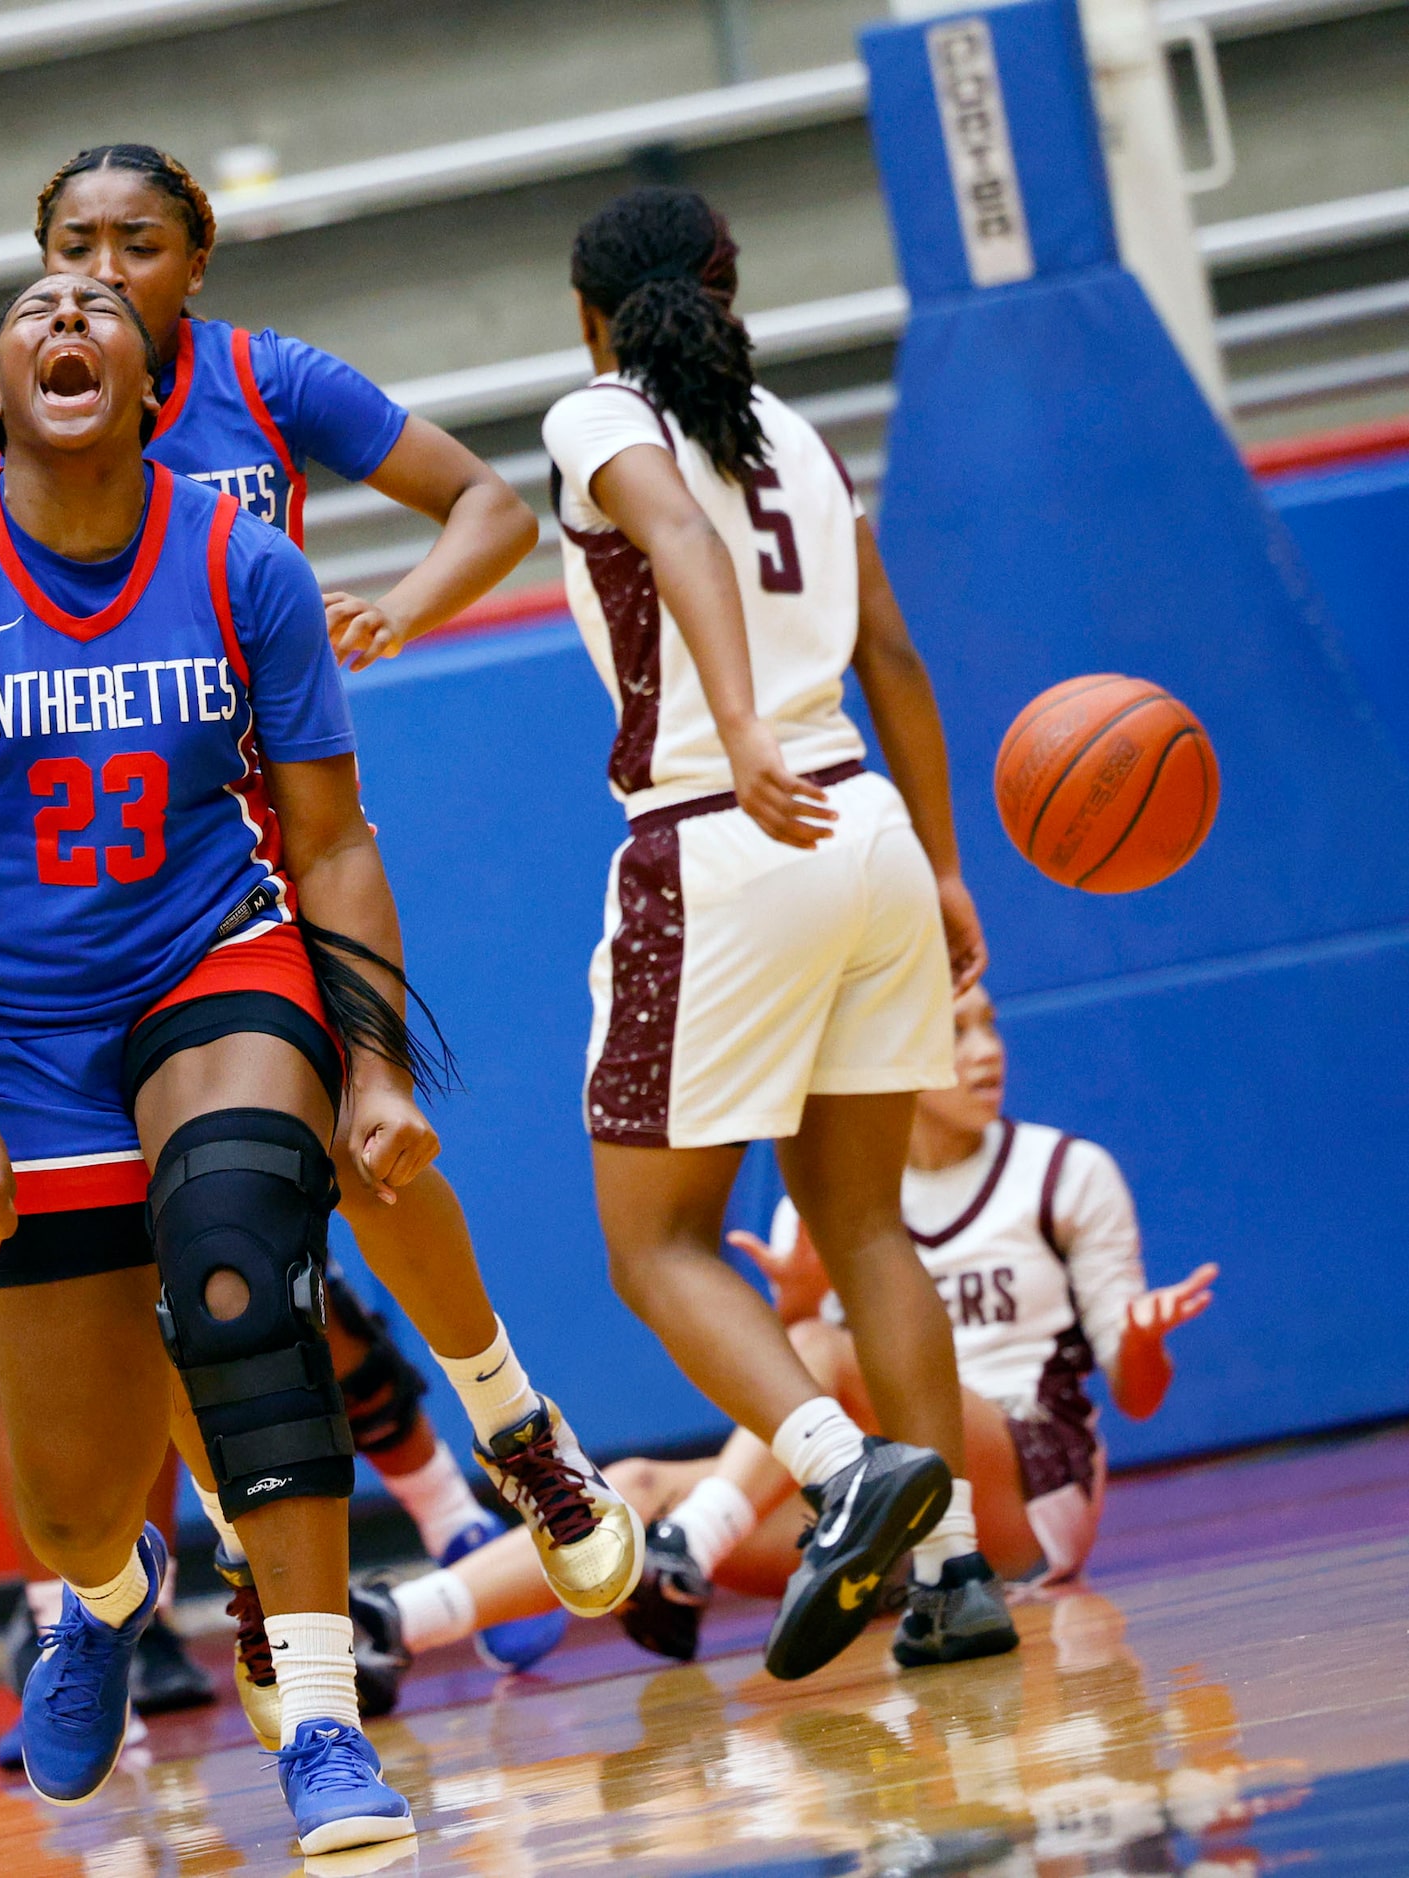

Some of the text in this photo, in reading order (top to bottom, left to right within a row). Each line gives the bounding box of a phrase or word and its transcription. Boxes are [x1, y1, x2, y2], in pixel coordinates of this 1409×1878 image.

[745, 463, 804, 594] 5
[27, 751, 169, 887] 23
[253, 895, 266, 911] M
